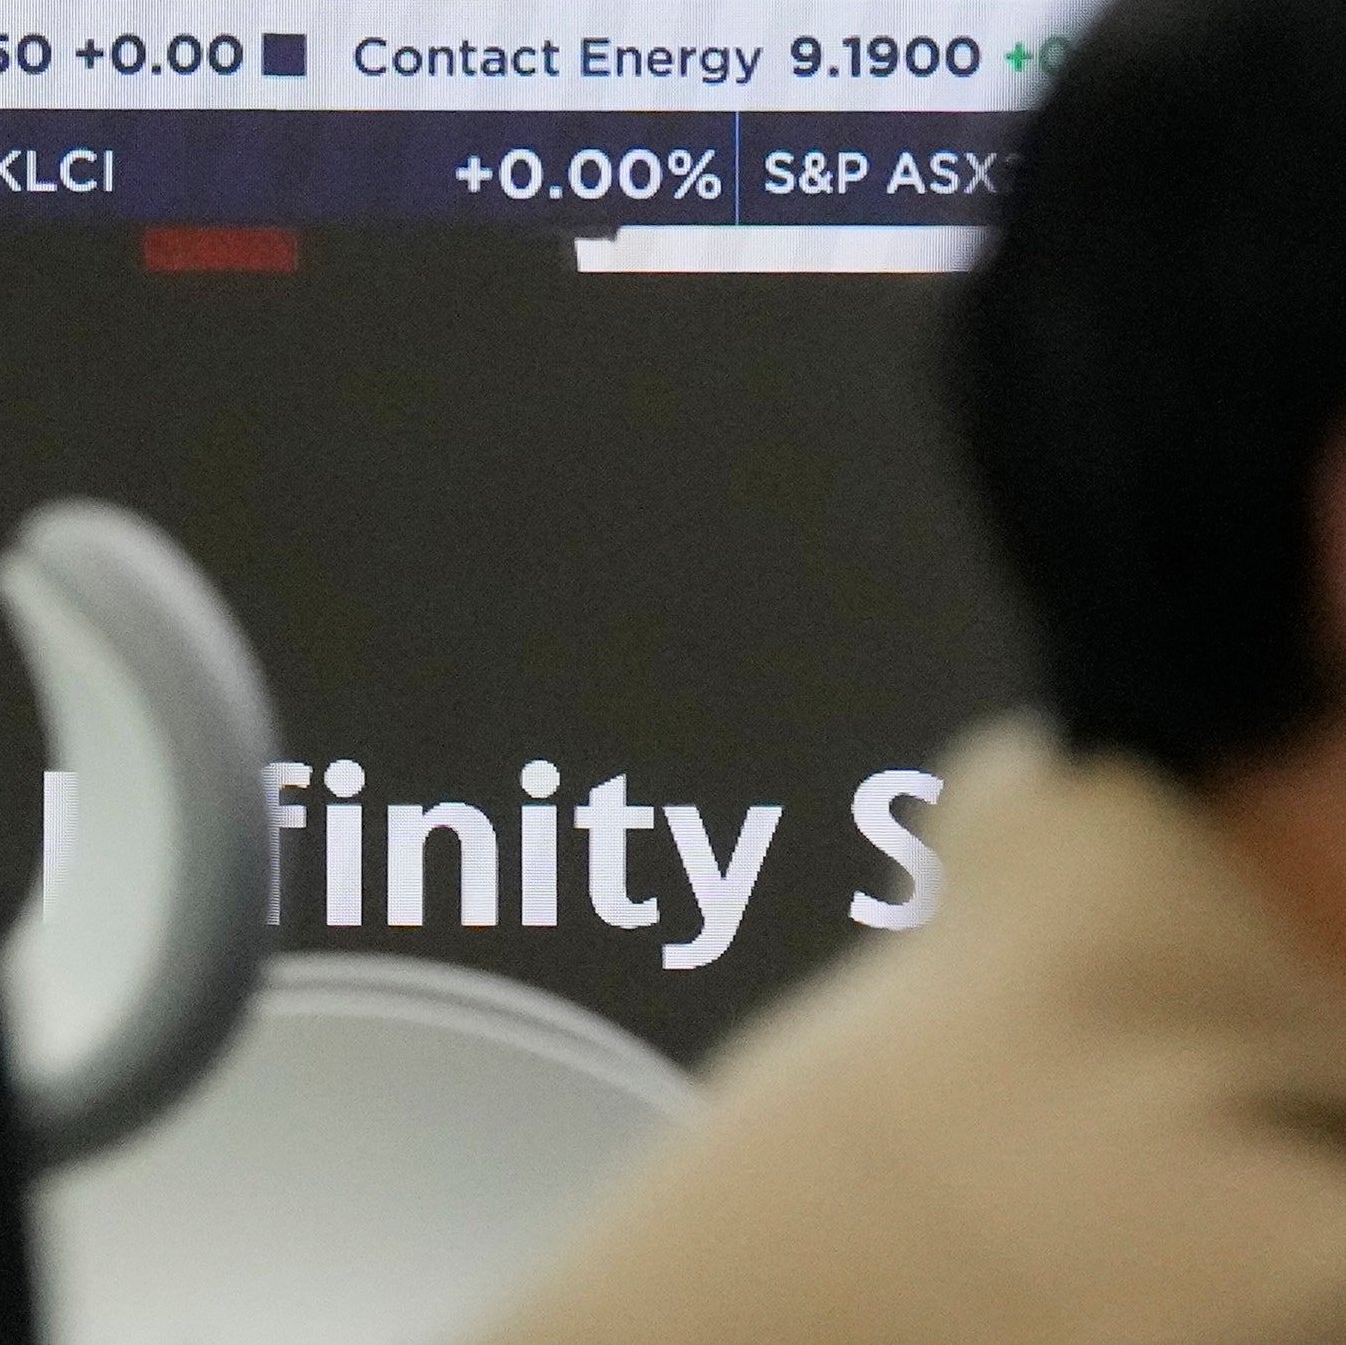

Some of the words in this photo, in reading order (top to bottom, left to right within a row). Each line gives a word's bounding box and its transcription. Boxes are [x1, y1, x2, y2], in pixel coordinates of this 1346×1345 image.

[76, 34, 245, 75] +0.00
[354, 38, 560, 78] Contact
[581, 38, 763, 84] Energy
[791, 36, 981, 78] 9.1900
[456, 148, 722, 200] +0.00%
[764, 150, 870, 196] S&P
[885, 151, 1018, 196] ASX
[42, 758, 783, 969] Ifinity
